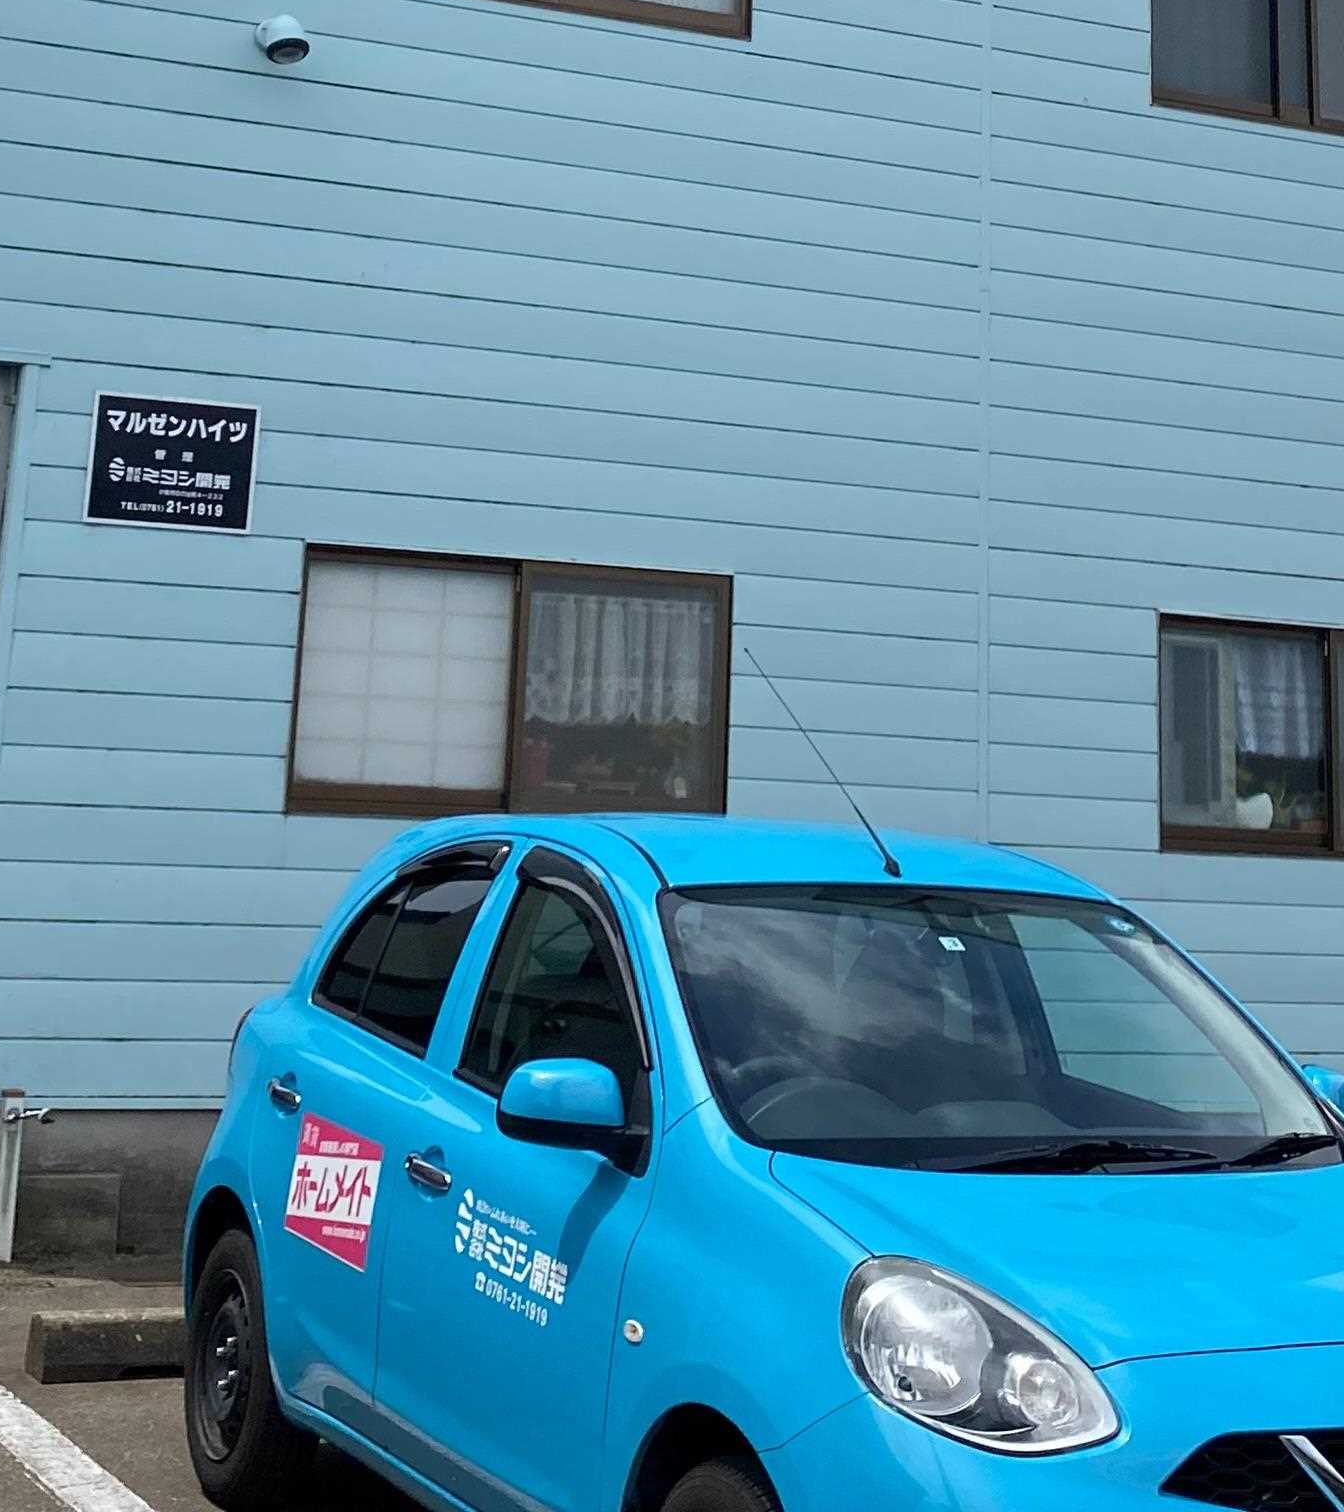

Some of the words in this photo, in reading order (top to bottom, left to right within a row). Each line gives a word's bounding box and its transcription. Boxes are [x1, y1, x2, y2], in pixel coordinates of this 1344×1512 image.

[107, 409, 248, 443] マルゼンハイツ
[291, 1161, 372, 1218] ホームメイト
